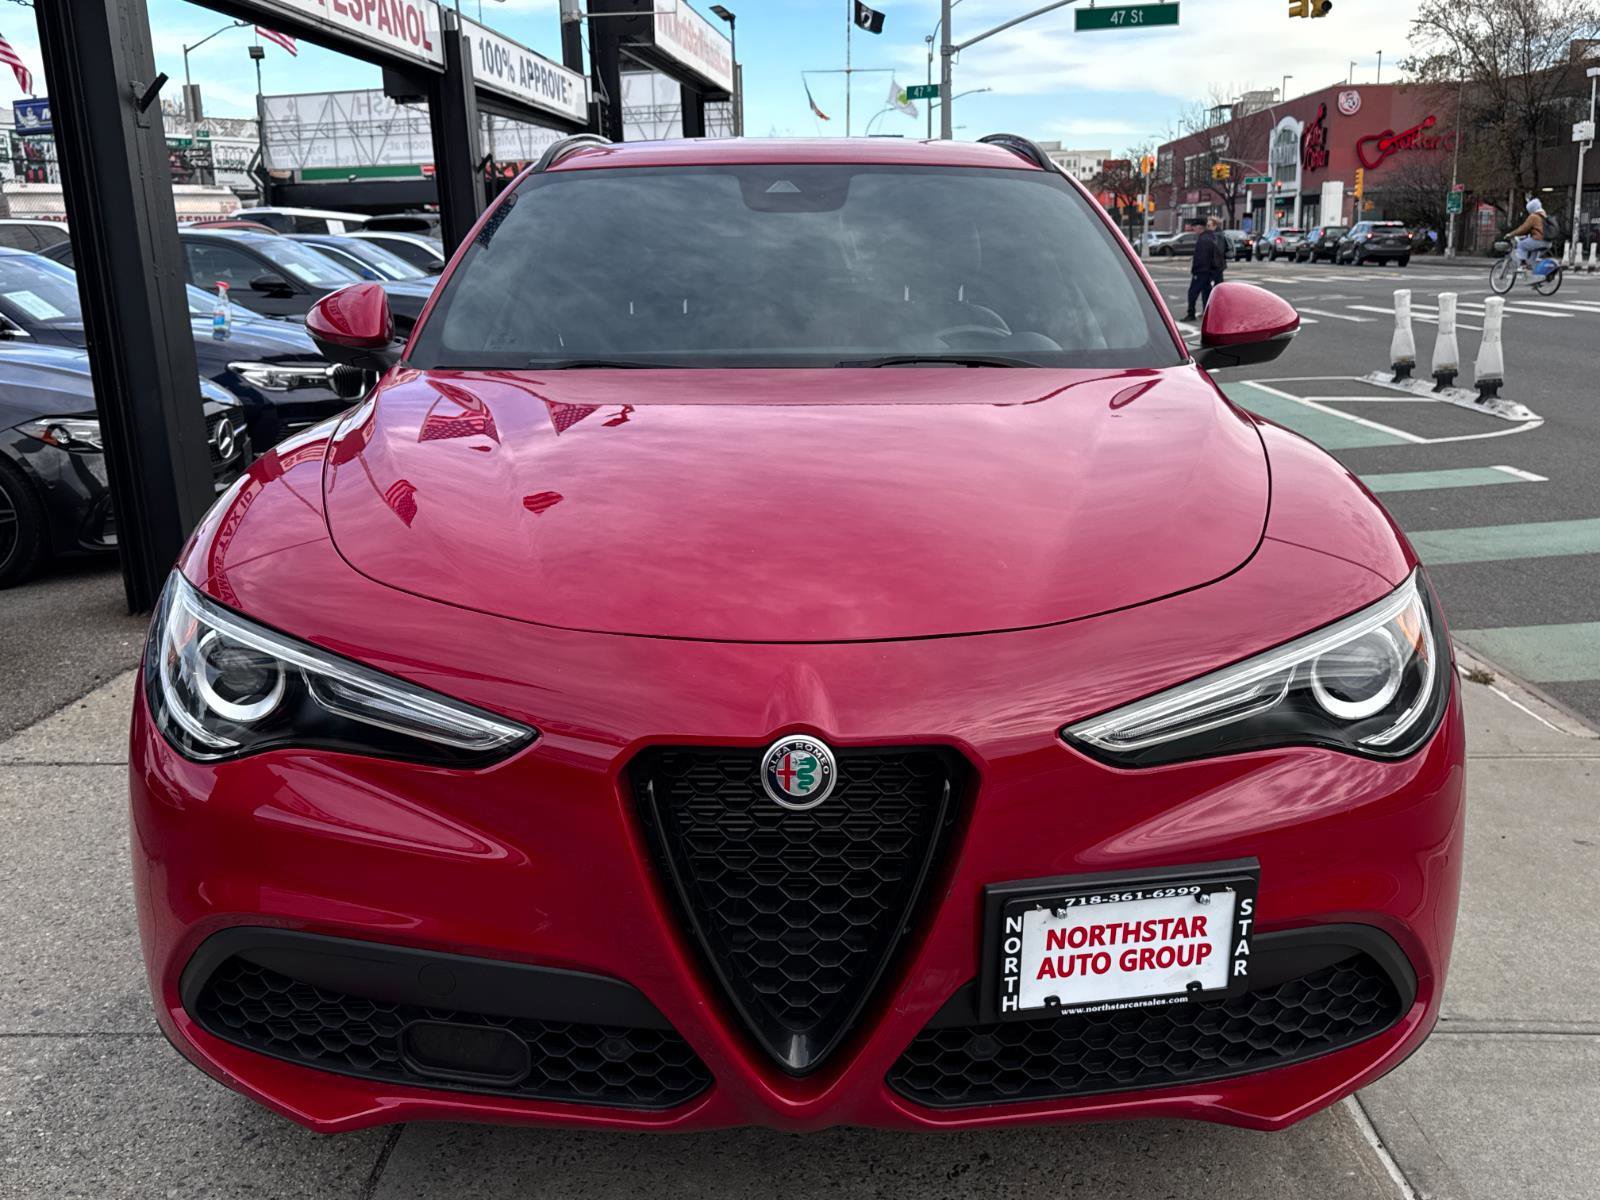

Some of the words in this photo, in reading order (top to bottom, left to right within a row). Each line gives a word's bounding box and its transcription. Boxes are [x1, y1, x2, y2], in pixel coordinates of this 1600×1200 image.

[1110, 11, 1126, 25] 47
[1130, 9, 1144, 24] St
[479, 37, 515, 84] 100%
[520, 55, 573, 106] APPROVE
[768, 746, 791, 774] ALFA
[795, 742, 830, 775] ROMEO
[1064, 886, 1201, 907] 718-361-6299
[1045, 915, 1208, 951] NORTHSTAR
[1234, 897, 1254, 977] STAR
[1001, 915, 1022, 1013] NORTH
[1036, 951, 1112, 980] AUTO
[1119, 943, 1212, 973] GROUP
[1061, 996, 1189, 1015] www.northstarcarsales.com
